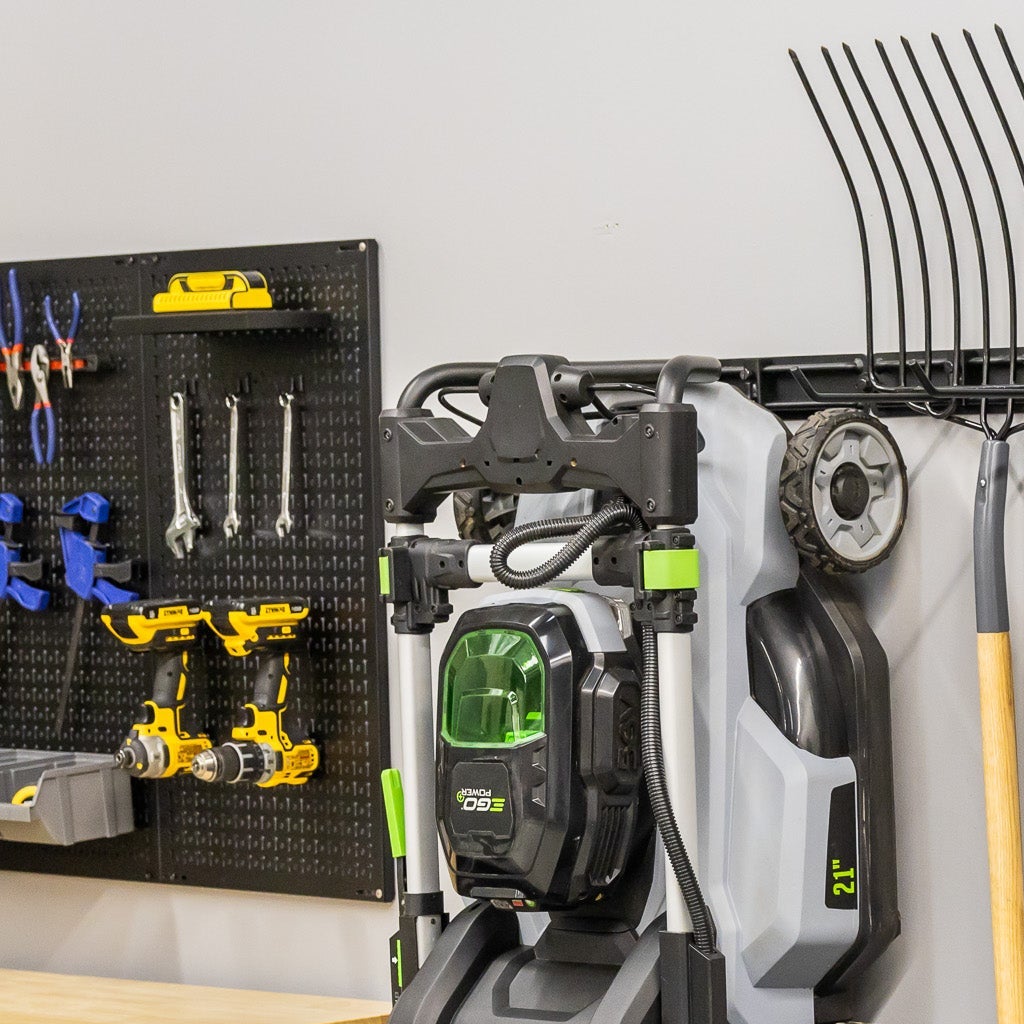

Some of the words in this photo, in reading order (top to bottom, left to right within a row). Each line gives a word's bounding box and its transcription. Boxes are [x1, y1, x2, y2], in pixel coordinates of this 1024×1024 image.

[461, 788, 492, 797] POWER
[461, 797, 506, 812] EGO
[832, 859, 855, 896] 21"
